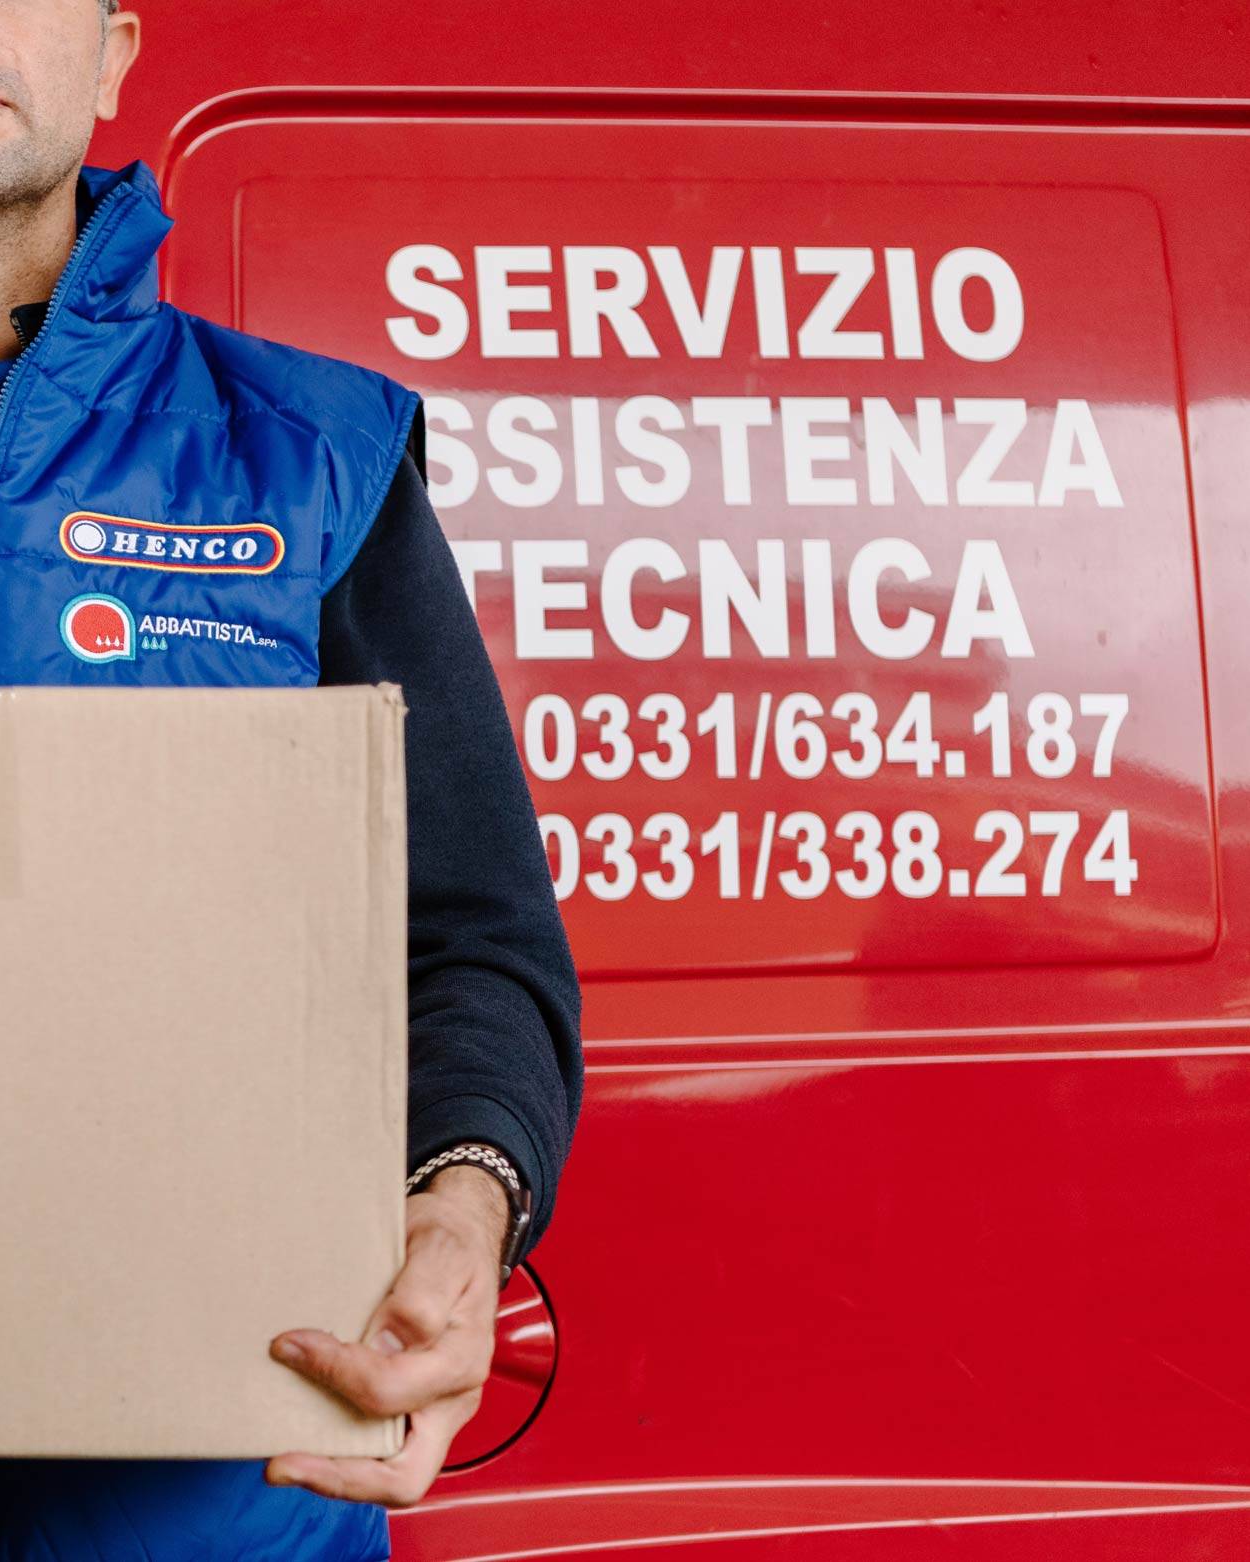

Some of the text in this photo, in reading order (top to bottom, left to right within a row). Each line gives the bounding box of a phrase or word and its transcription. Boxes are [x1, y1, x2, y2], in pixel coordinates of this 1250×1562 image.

[386, 244, 1024, 361] SERVIZIO
[423, 396, 1125, 508] SSISTENZA
[111, 531, 258, 560] HENCO
[524, 692, 1130, 780] 0331/634.187
[537, 810, 1138, 900] 0331/338.274
